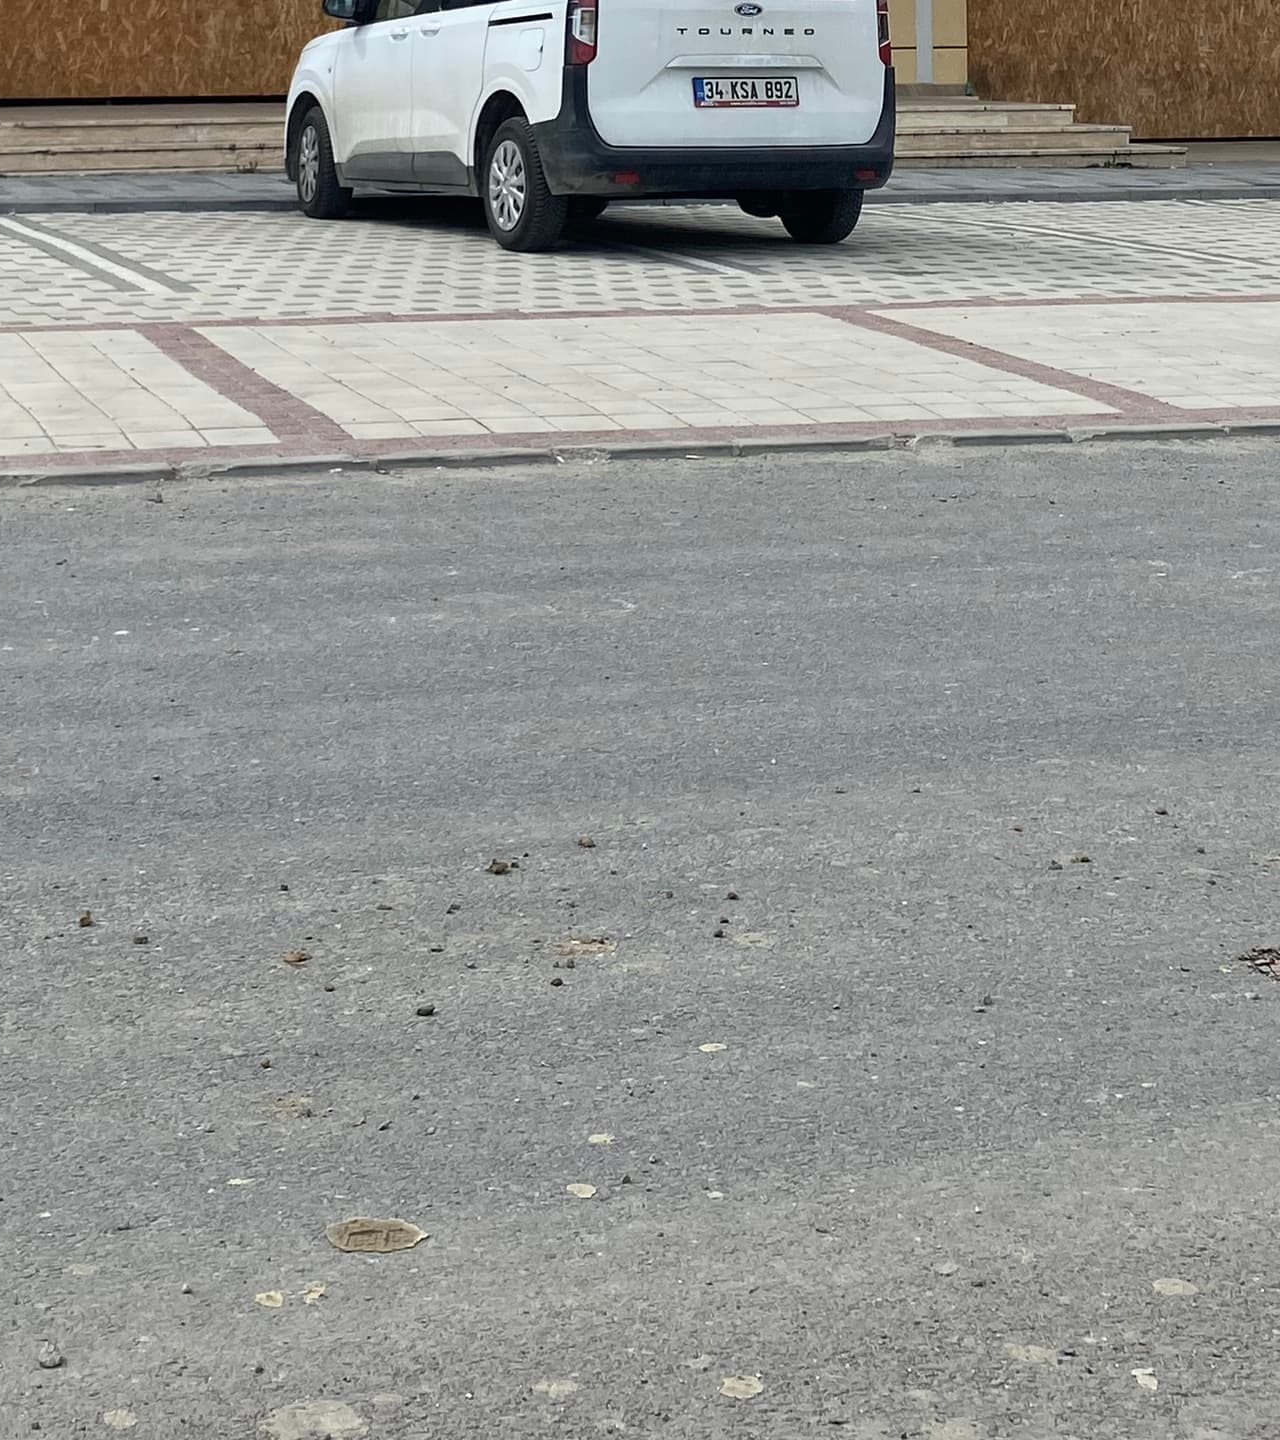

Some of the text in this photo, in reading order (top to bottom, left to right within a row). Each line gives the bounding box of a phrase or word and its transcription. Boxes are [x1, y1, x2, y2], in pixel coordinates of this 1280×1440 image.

[676, 27, 815, 36] TOURNEO
[705, 80, 793, 100] 34 KSA 892
